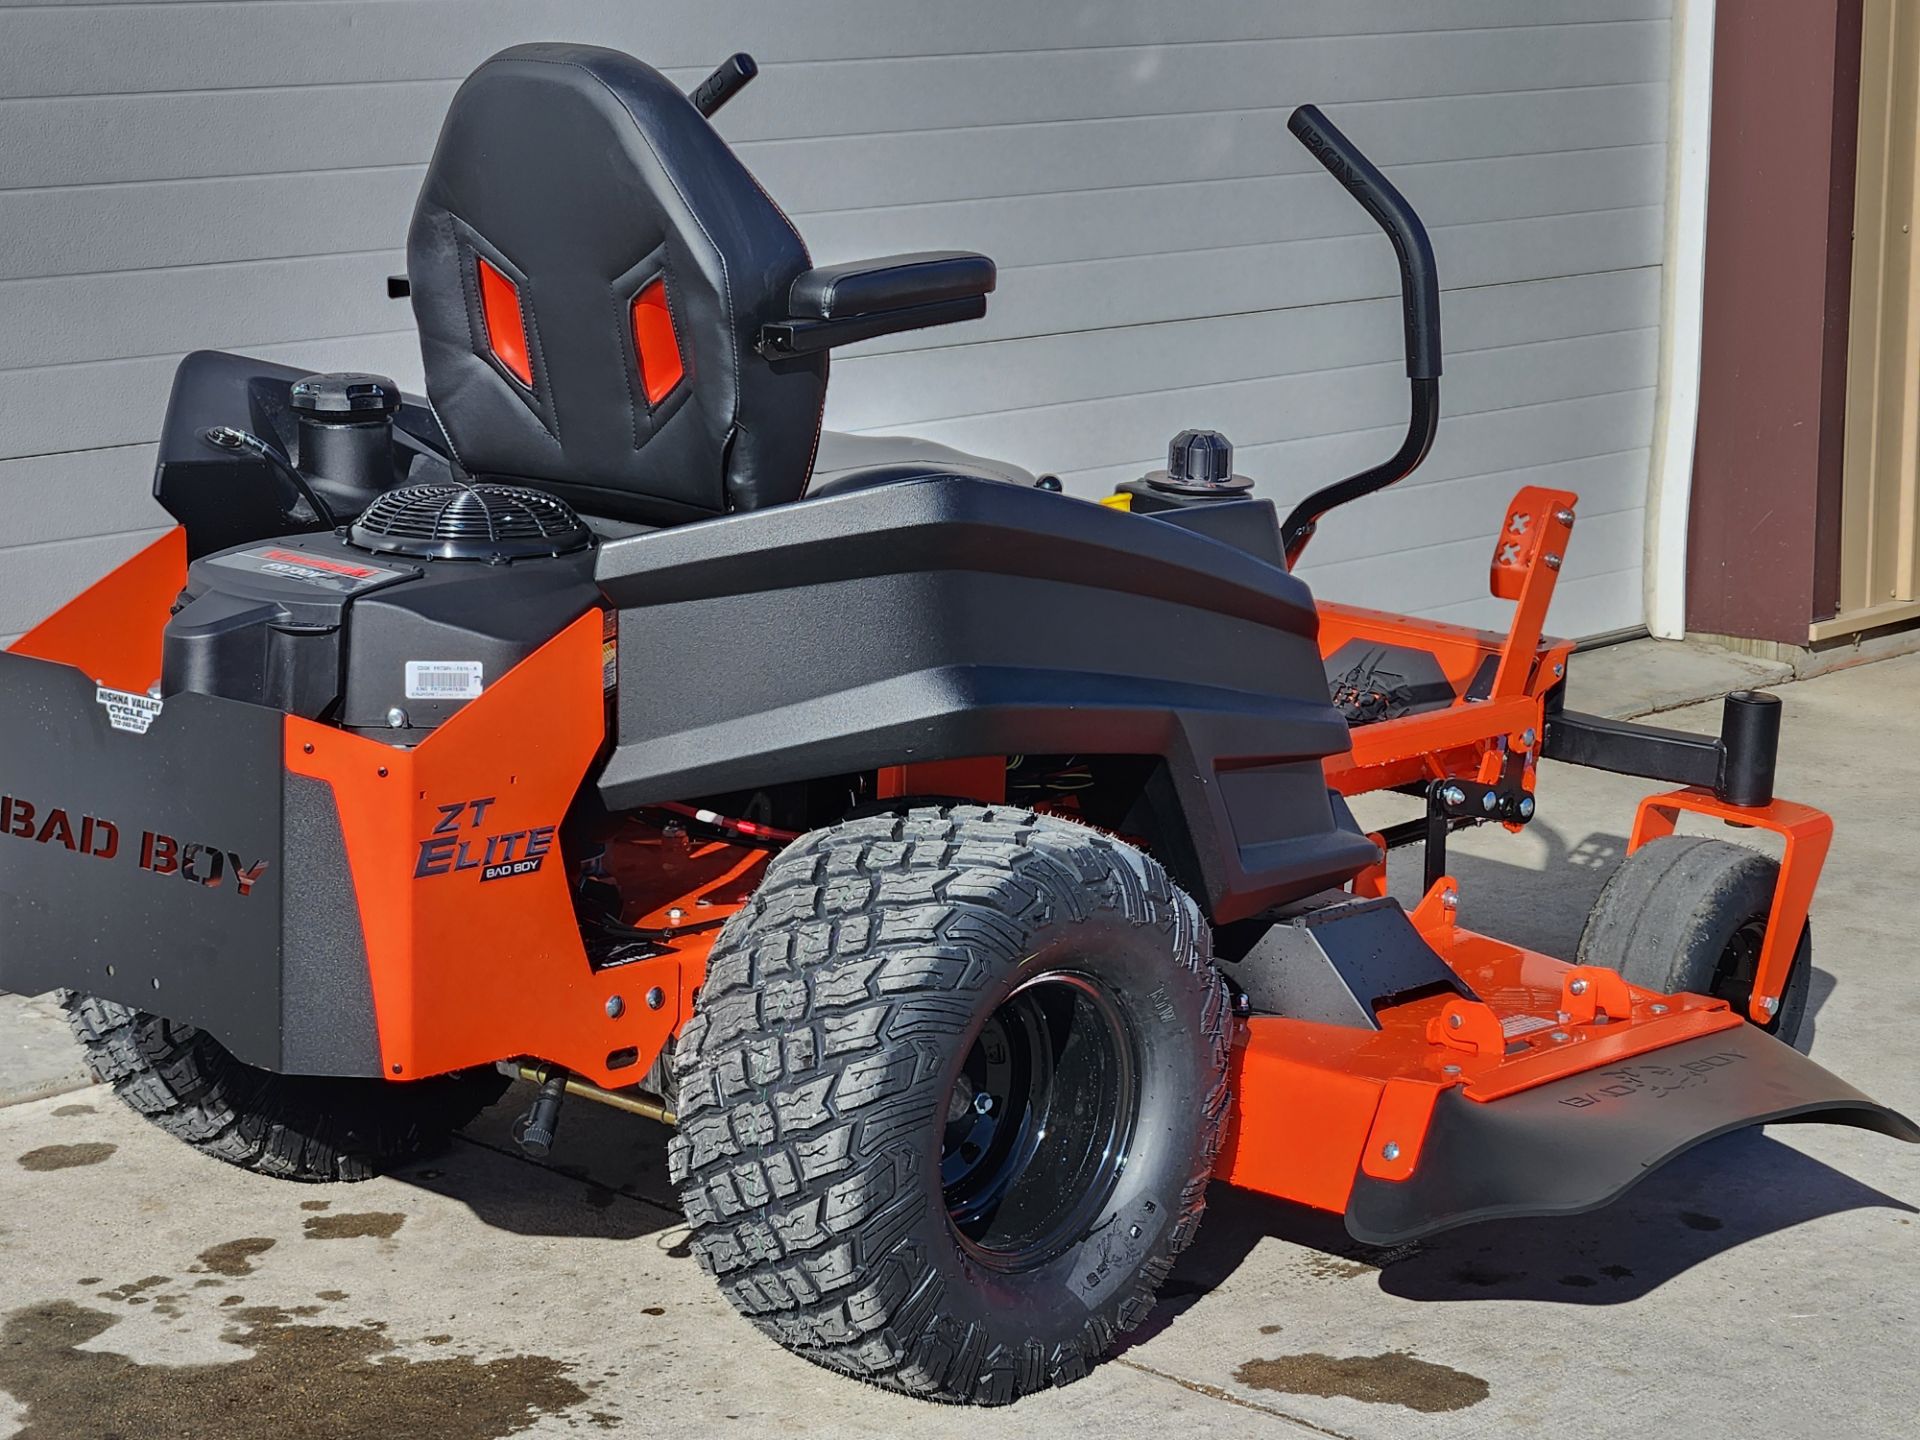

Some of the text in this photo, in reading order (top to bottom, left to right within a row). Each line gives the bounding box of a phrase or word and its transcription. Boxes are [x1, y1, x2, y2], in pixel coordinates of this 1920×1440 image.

[109, 704, 143, 718] CYCLE
[131, 697, 160, 712] VALLEY
[432, 797, 496, 834] ZT
[0, 796, 269, 897] BAD BOY
[413, 825, 556, 879] ELITE
[486, 859, 539, 879] BAD BOY
